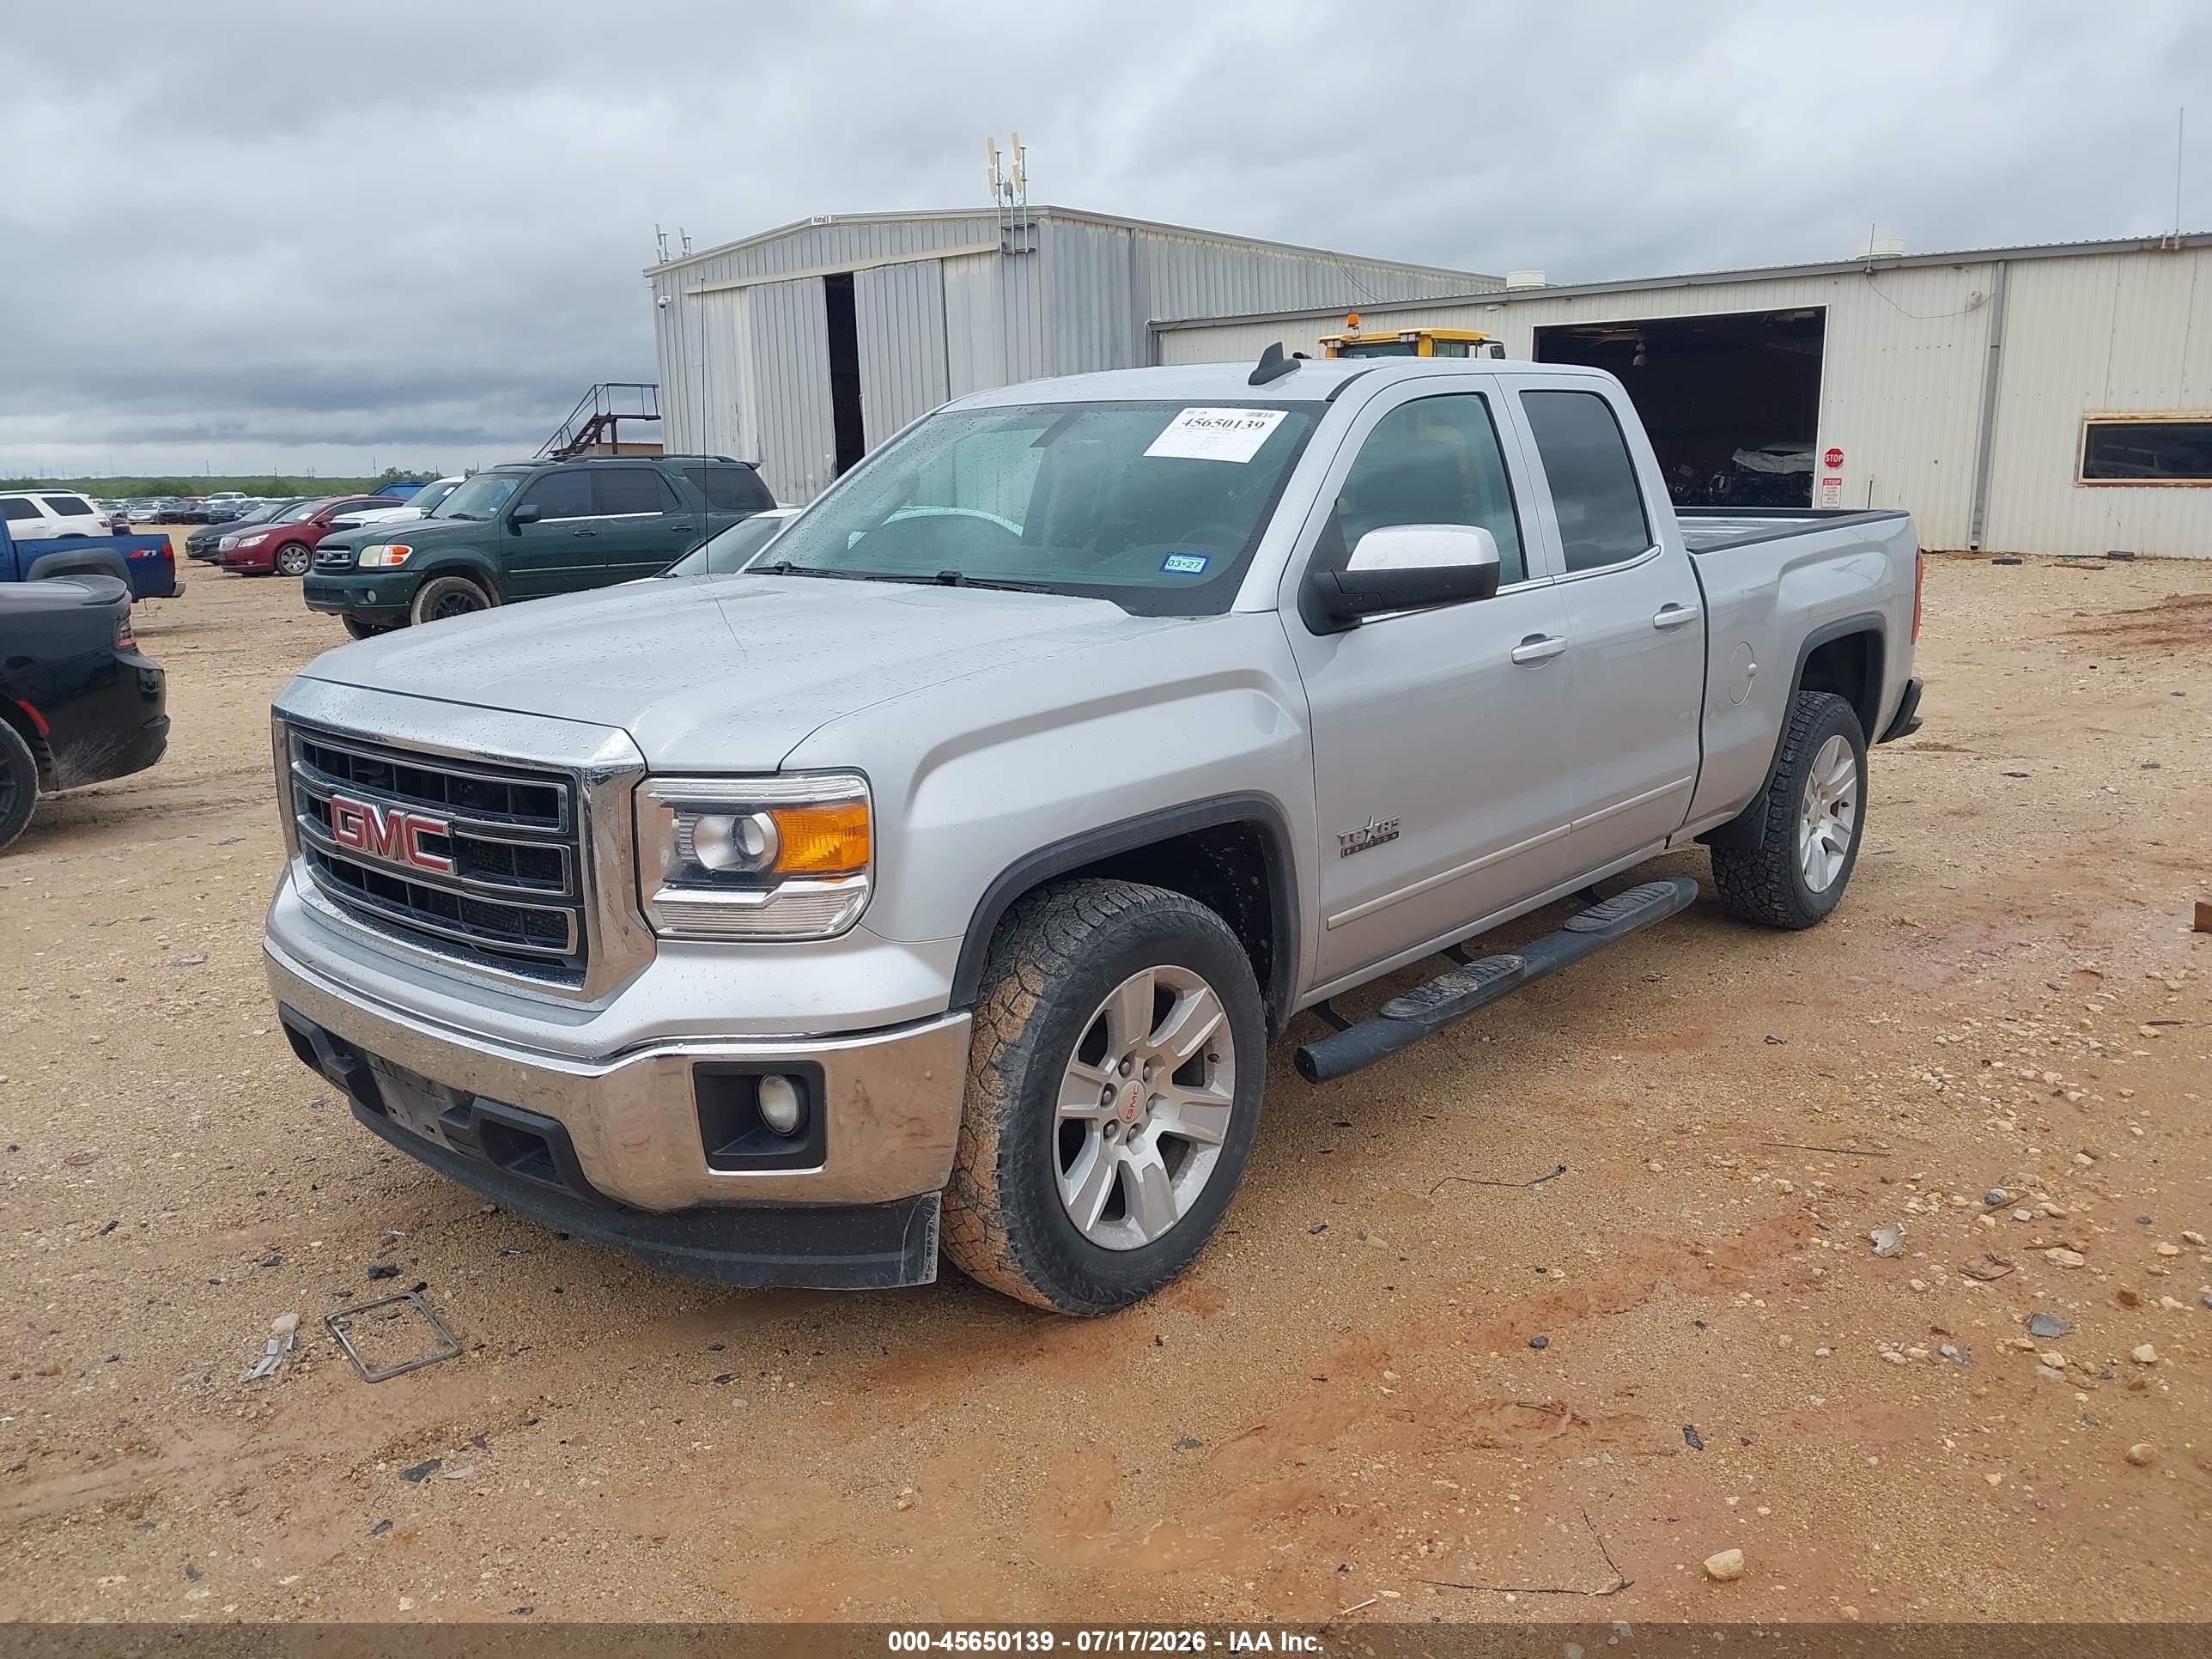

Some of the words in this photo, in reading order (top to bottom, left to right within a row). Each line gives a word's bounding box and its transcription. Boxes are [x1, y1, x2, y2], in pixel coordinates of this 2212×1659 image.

[1182, 417, 1265, 430] 45650139
[1826, 453, 1843, 462] STOP
[1168, 559, 1202, 569] 03-27
[331, 793, 453, 875] GMC
[1126, 1084, 1139, 1120] GMC
